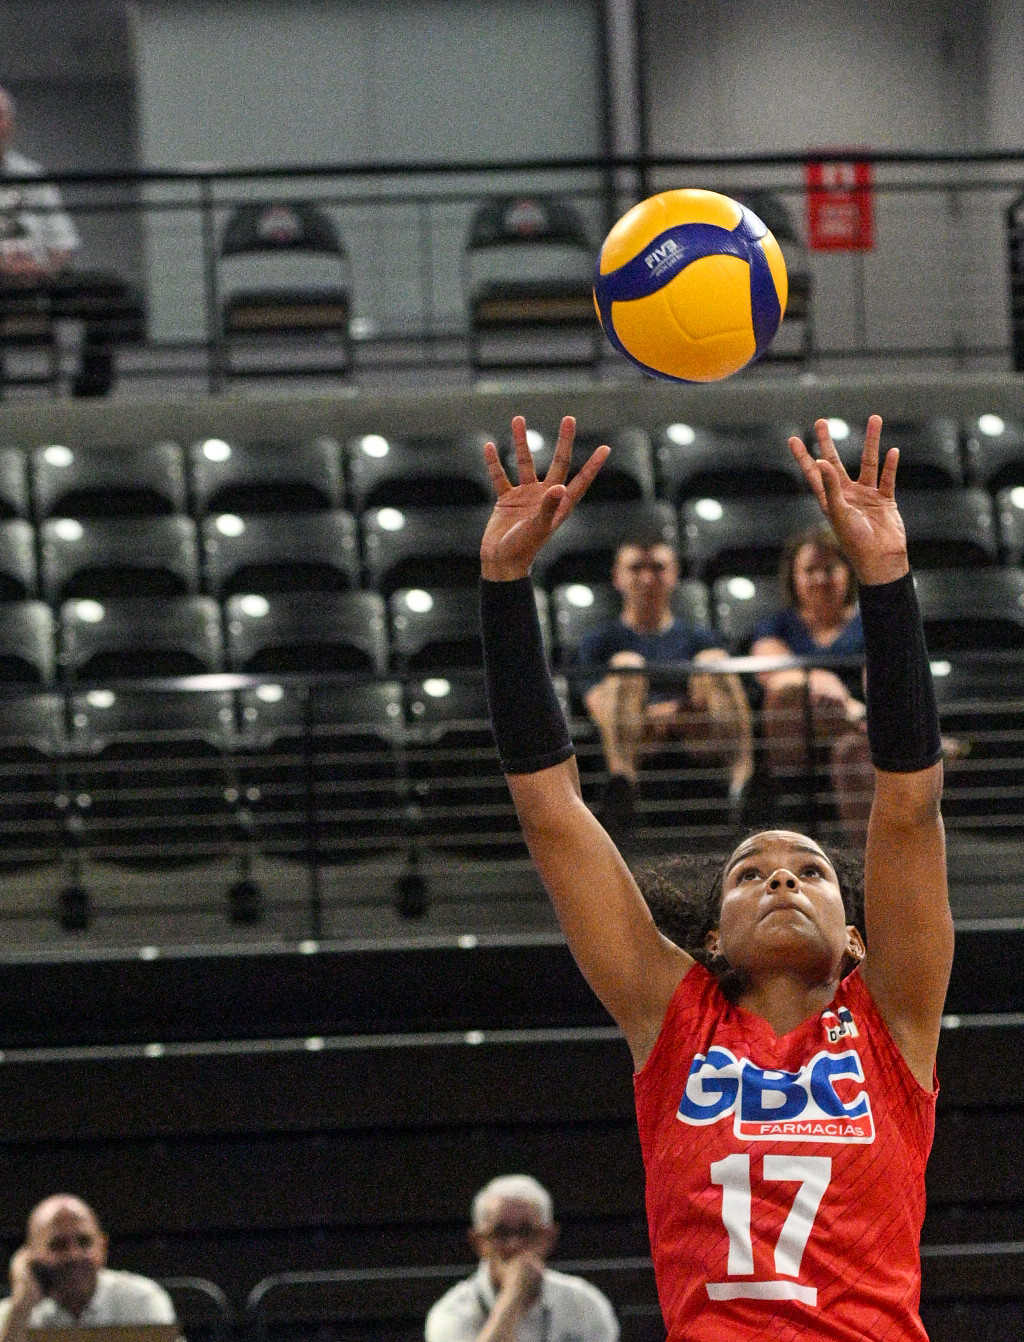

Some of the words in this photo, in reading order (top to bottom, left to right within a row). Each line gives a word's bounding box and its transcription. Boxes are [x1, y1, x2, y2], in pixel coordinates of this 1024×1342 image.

[676, 1045, 872, 1127] GBC
[759, 1122, 865, 1137] FARMACIAS
[710, 1153, 832, 1278] 17
